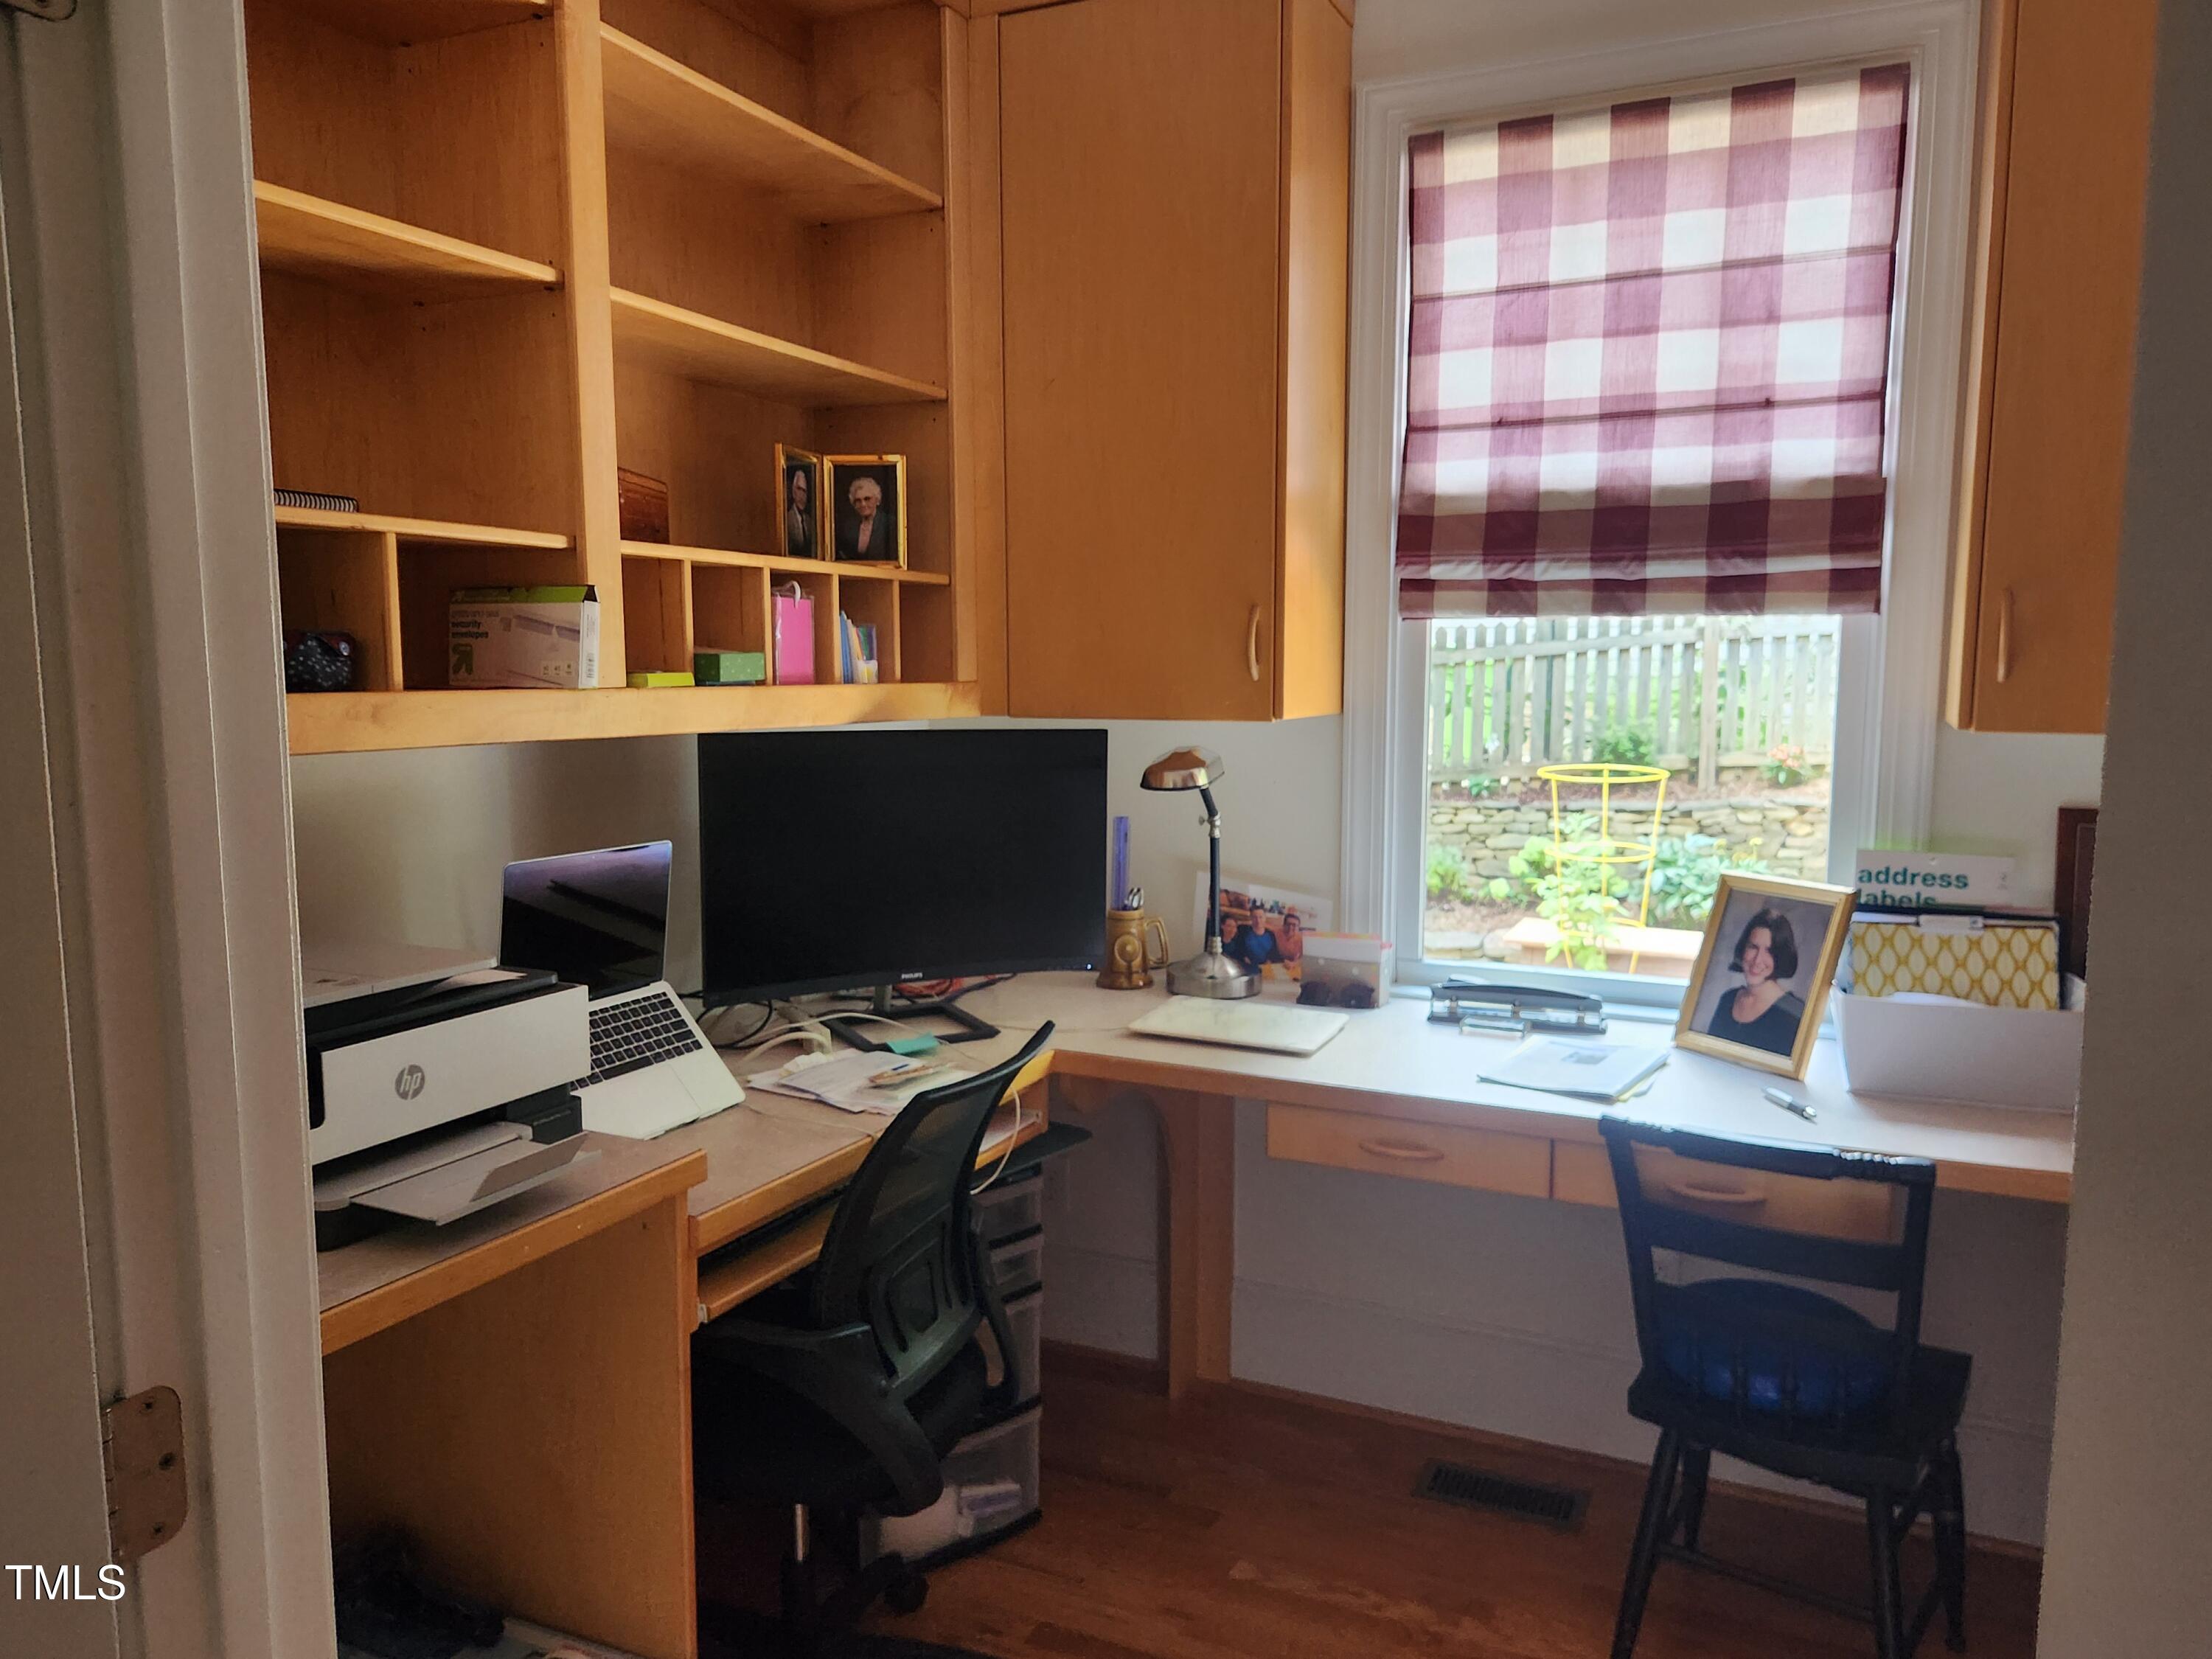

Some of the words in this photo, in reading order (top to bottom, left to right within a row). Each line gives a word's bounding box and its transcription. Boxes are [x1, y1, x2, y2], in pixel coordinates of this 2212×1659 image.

[1858, 866, 1969, 890] address
[1857, 888, 1936, 906] labels
[397, 1064, 423, 1099] hp
